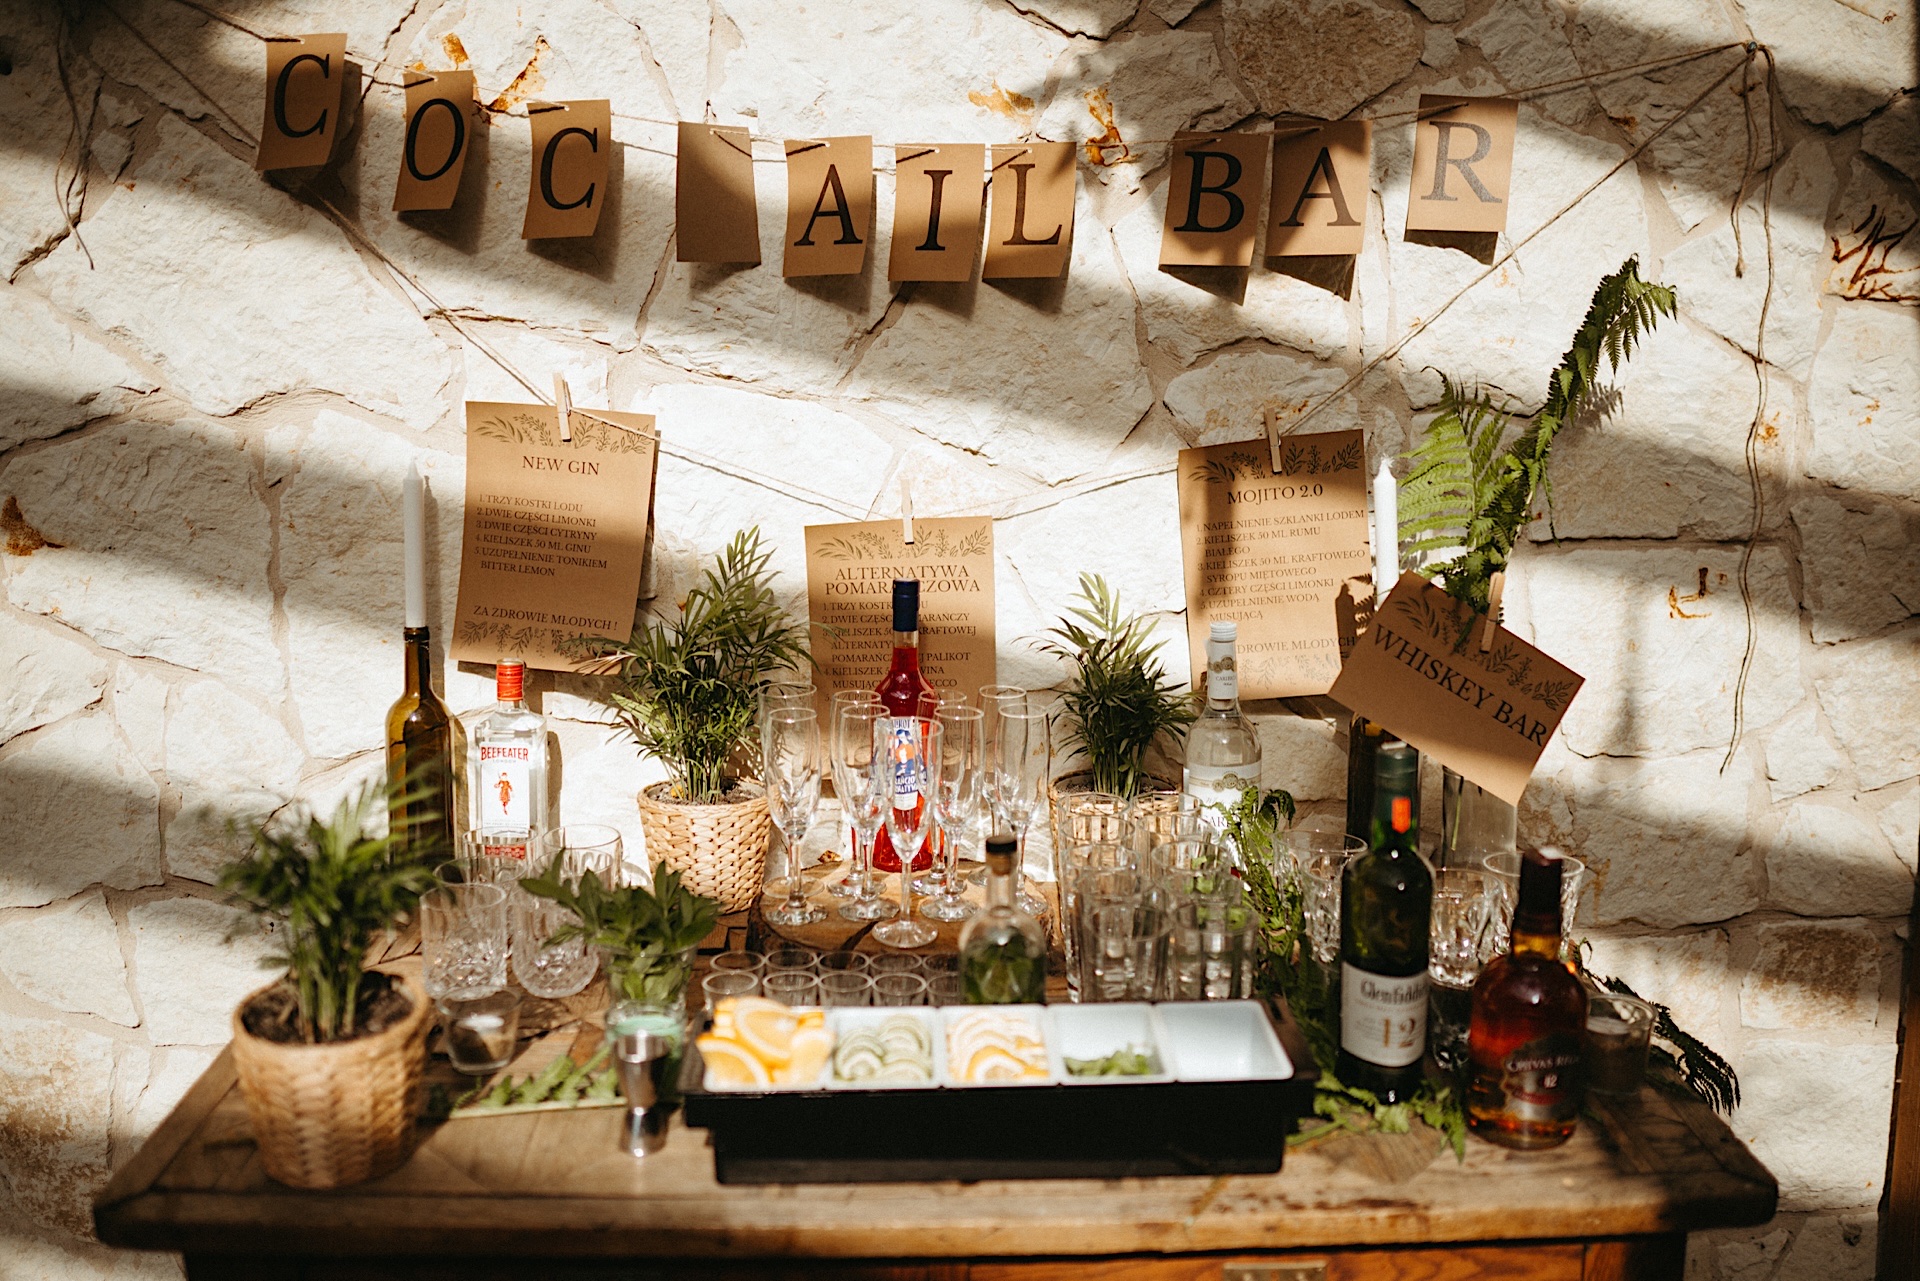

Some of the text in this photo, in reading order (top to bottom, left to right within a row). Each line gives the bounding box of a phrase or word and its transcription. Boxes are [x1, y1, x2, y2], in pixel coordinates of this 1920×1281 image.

[1173, 120, 1503, 232] BAR
[522, 455, 600, 476] NEW GIN
[1227, 483, 1324, 506] MOJITO 2.0
[514, 497, 552, 509] KOSTKI
[554, 501, 583, 512] LODU
[514, 510, 549, 523] CZĘŚCI
[551, 514, 596, 527] LIMONKI
[1273, 513, 1324, 526] SZKLANKI
[1326, 509, 1365, 522] LODEM
[513, 523, 548, 536] CZĘŚCI
[550, 527, 597, 541] CYTRYNY
[1257, 531, 1270, 540] 50
[1271, 529, 1288, 540] ML
[1289, 526, 1321, 538] RUMU
[534, 540, 546, 549] 50
[548, 541, 564, 551] ML
[565, 542, 592, 553] GINU
[1205, 546, 1250, 558] BIAŁEGO
[556, 555, 607, 569] TONIKIEM
[1259, 556, 1272, 566] 50
[1273, 555, 1290, 565] ML
[1291, 549, 1365, 564] KRAFTOWEGO
[480, 560, 556, 576] BITTER LEMON
[1206, 566, 1317, 584] SYROPU MIĘTOWEGO
[1250, 581, 1286, 594] CZĘŚCI
[1288, 578, 1334, 590] LIMONKI
[859, 601, 893, 610] KOSTK
[1286, 592, 1320, 603] WODĄ
[474, 605, 490, 616] ZA
[491, 607, 548, 622] ZDROWIE
[550, 613, 612, 630] MŁODYCH
[860, 613, 893, 625] CZĘŚC
[1209, 609, 1264, 622] MUSUJĄCĄ
[831, 640, 893, 650] ALTERNATY
[1237, 636, 1356, 655] DROWIE MŁODYCH
[927, 652, 971, 662] PALIKOT
[1373, 622, 1548, 747] WHISKEY BAR
[481, 746, 529, 761] BEEFEATER
[1383, 1017, 1416, 1049] 12
